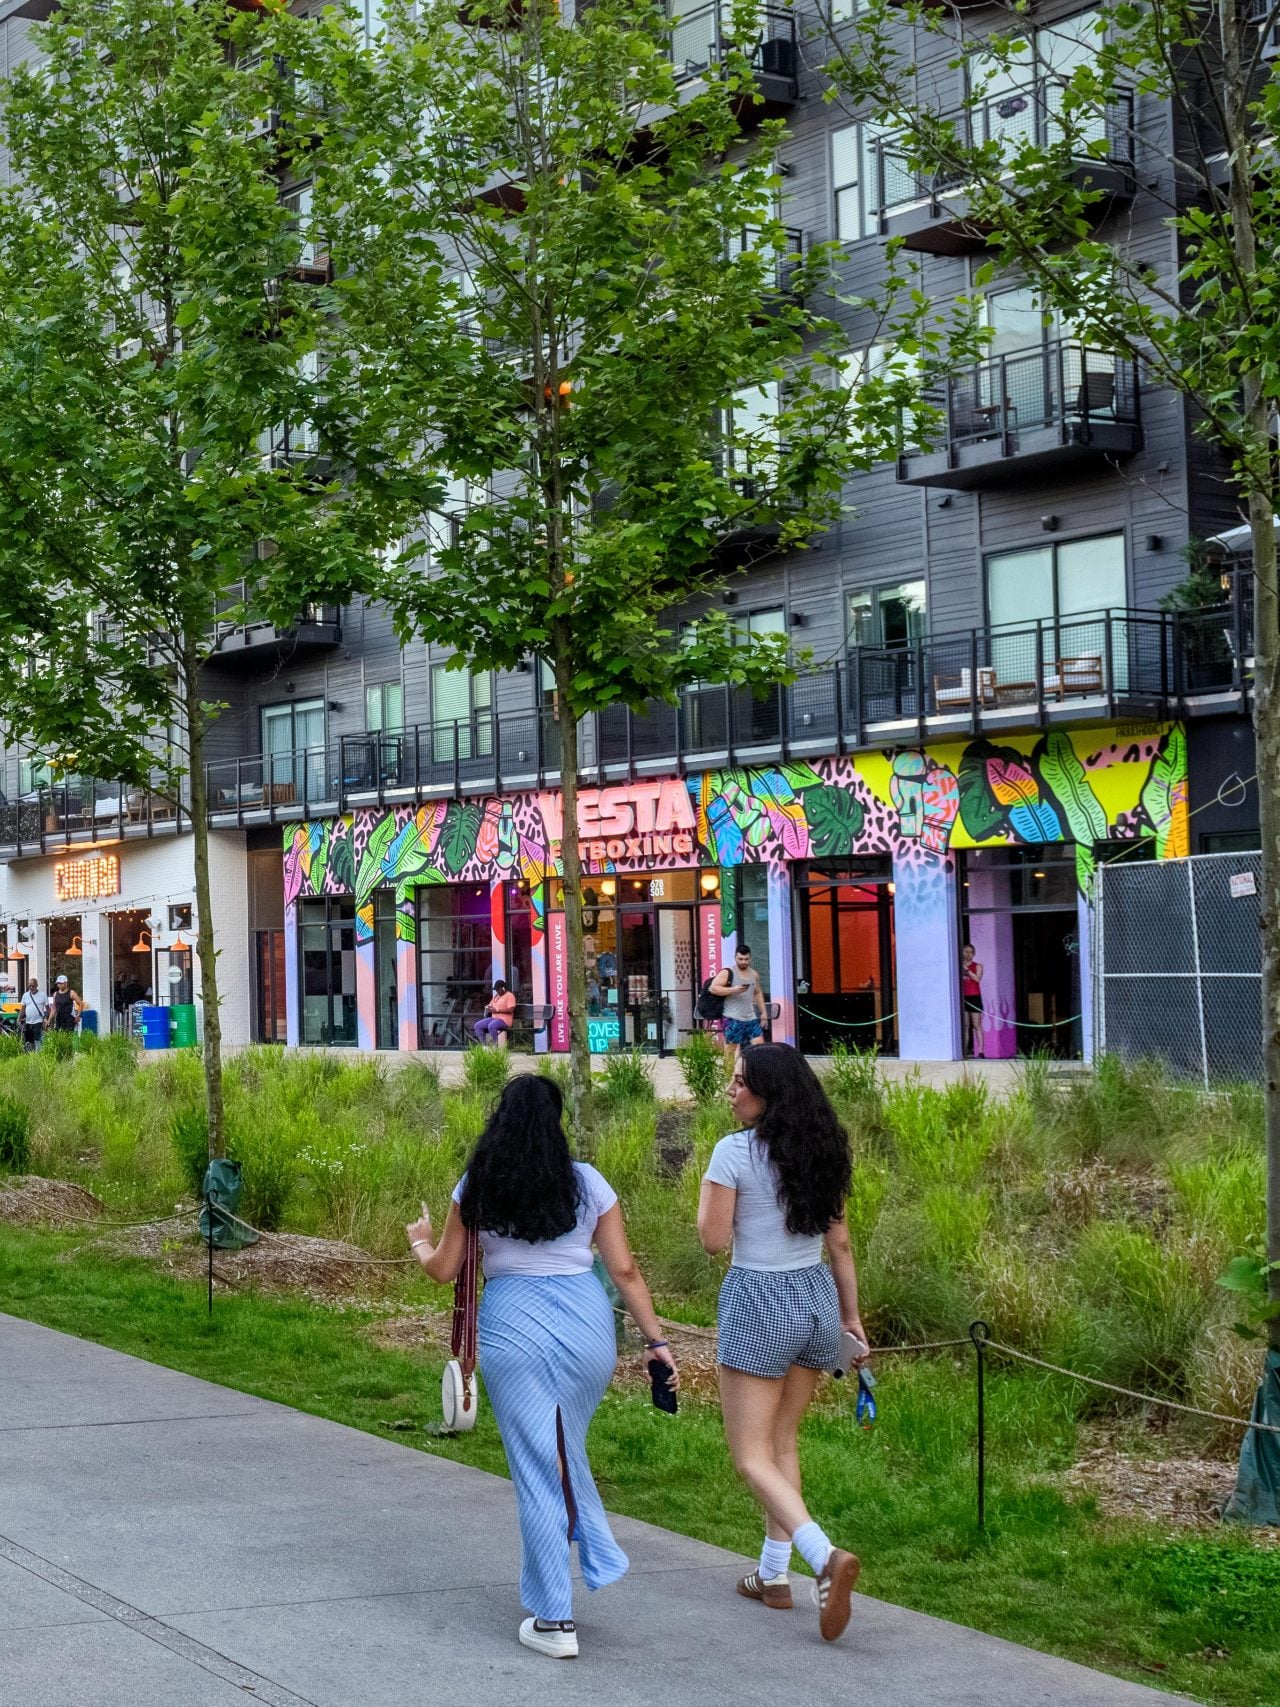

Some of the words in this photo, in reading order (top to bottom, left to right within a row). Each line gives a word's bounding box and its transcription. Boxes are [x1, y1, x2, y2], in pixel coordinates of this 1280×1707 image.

[538, 780, 696, 841] VESTA
[550, 834, 693, 864] FTBOXING
[707, 913, 715, 935] LIVE
[708, 938, 716, 960] LIKE
[588, 1022, 620, 1038] OVES
